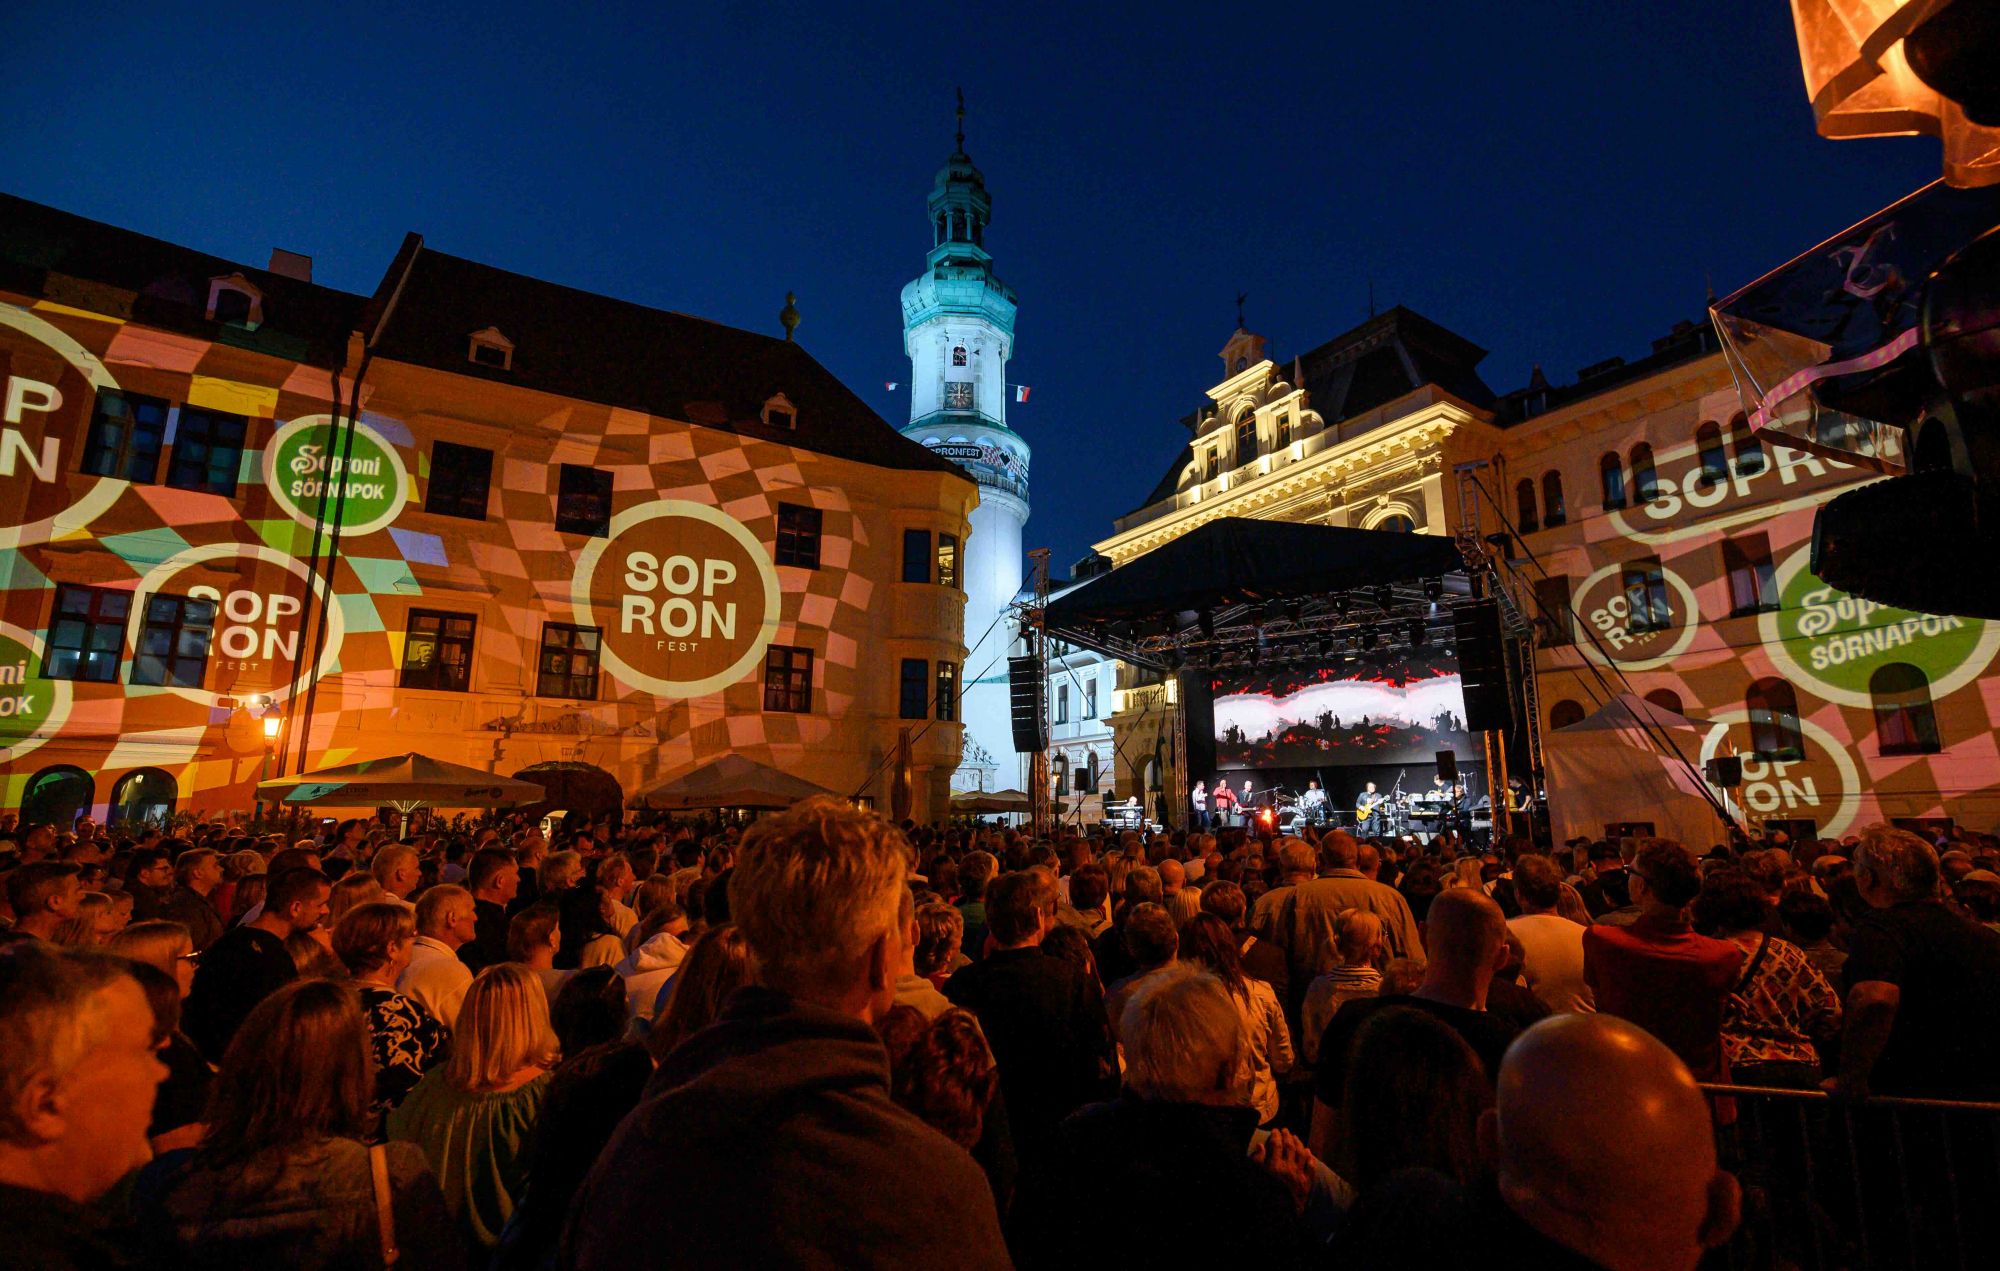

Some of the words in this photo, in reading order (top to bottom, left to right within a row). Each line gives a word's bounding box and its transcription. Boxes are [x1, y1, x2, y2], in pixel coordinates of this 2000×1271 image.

[290, 444, 381, 479] Soponi
[624, 551, 737, 597] SOP
[621, 594, 737, 640] RON
[208, 625, 299, 661] ON
[657, 640, 699, 652] FEST
[215, 661, 259, 671] FEST
[1743, 776, 1820, 812] ON
